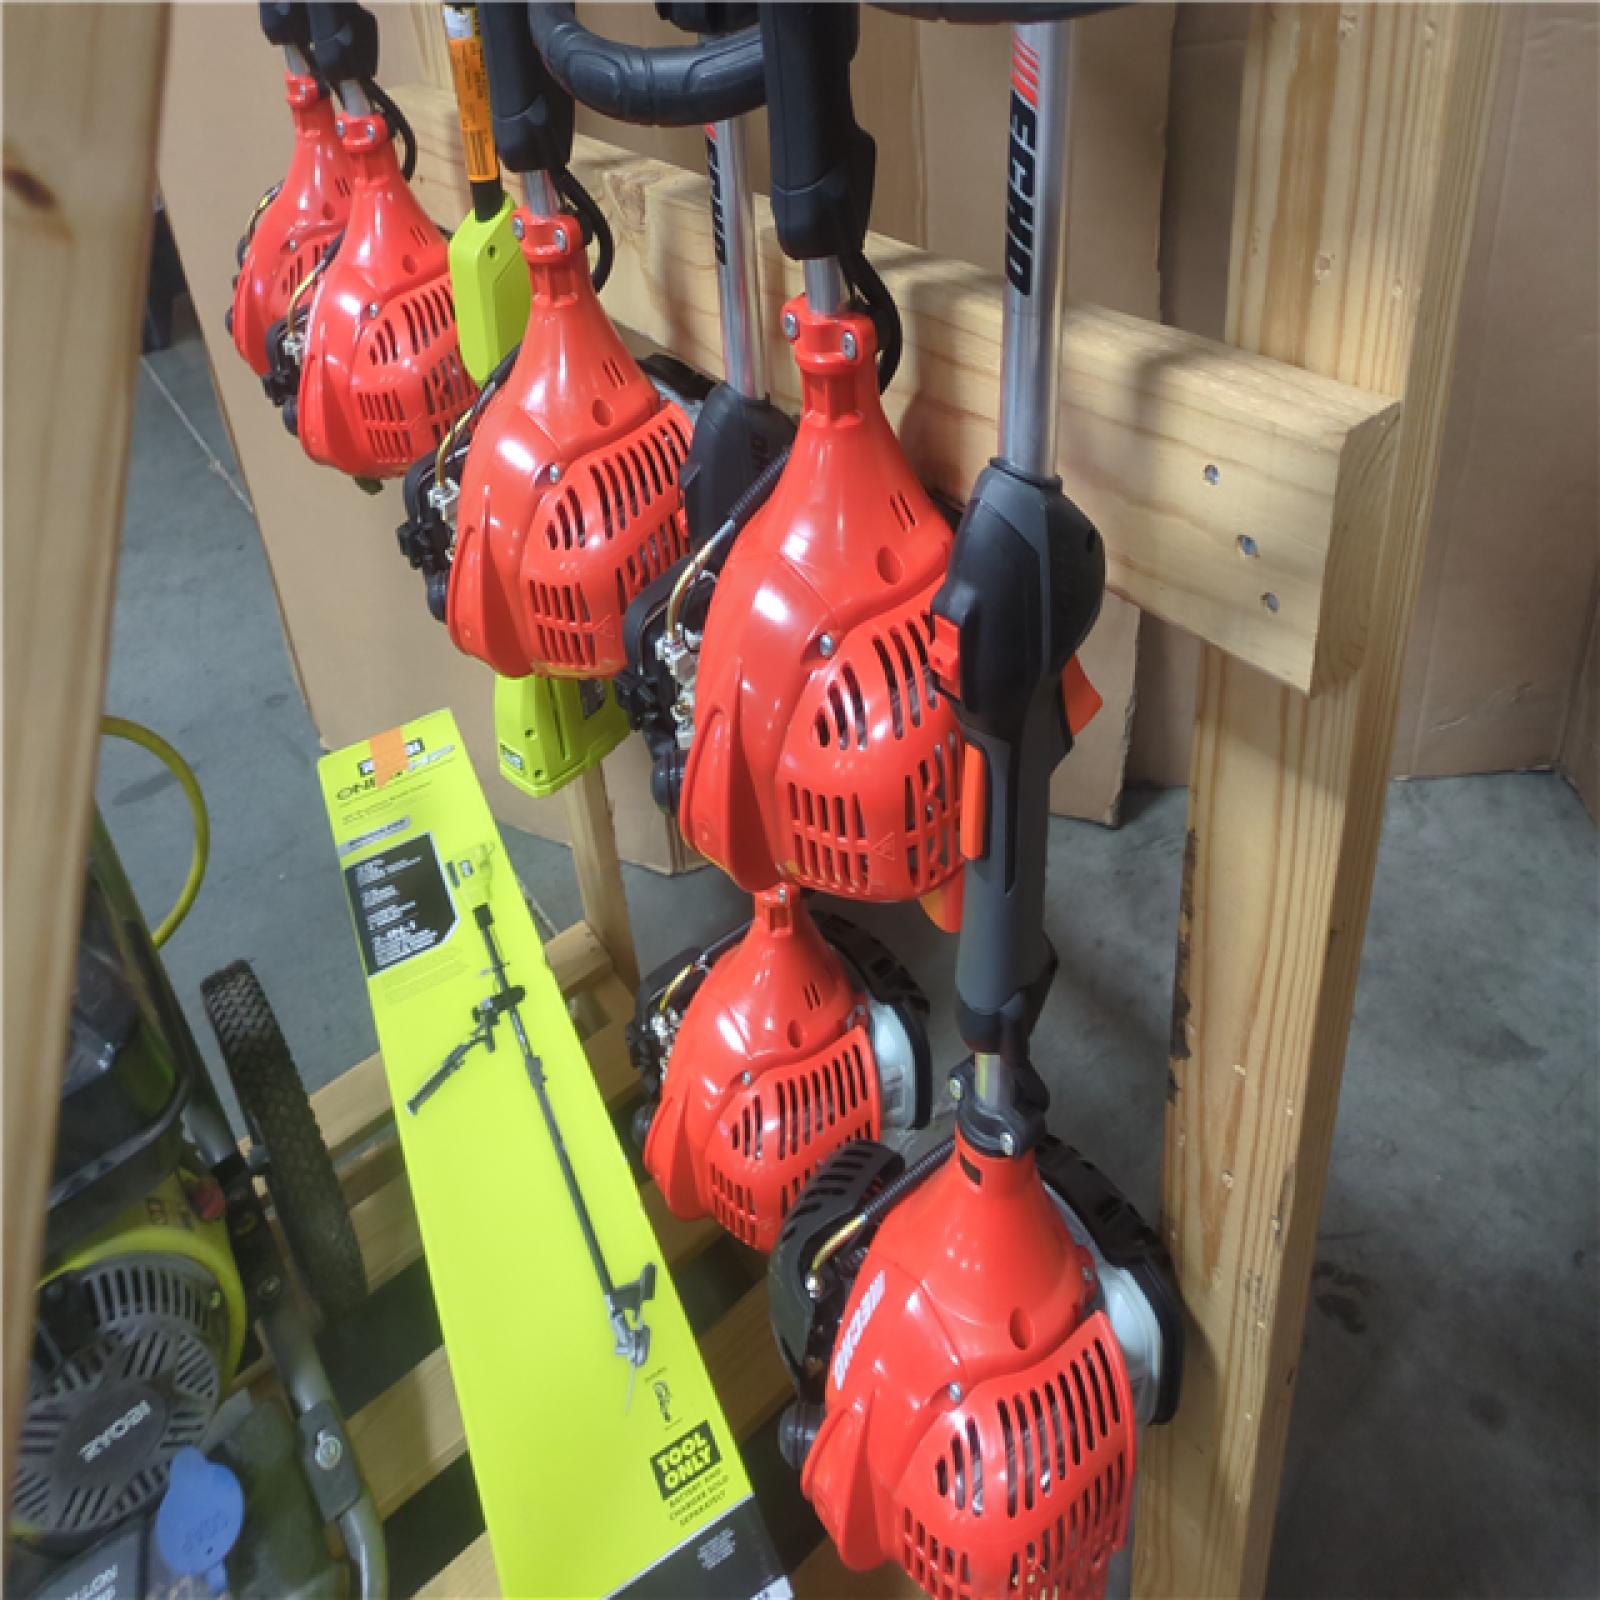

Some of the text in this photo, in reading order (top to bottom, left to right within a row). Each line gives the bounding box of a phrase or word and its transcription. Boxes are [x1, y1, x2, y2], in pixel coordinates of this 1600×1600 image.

[1007, 88, 1037, 297] ECHO
[657, 1432, 706, 1472] TOOL
[664, 1445, 711, 1489] ONLY
